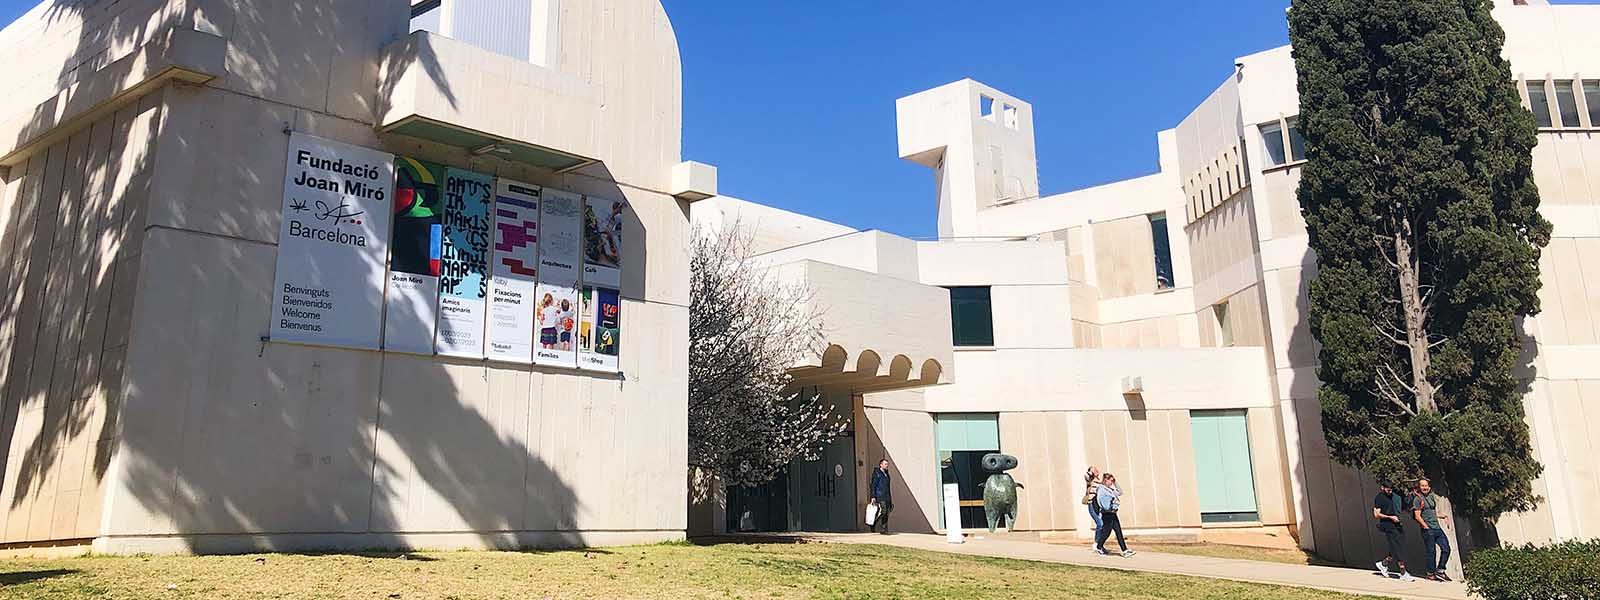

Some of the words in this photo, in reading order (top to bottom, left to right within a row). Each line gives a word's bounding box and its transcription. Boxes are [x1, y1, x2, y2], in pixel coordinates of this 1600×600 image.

[297, 150, 379, 180] Fundació
[294, 171, 339, 192] Joan
[344, 180, 385, 201] Miró
[289, 220, 366, 247] Barcelona
[392, 275, 408, 283] Joan
[408, 277, 423, 285] Miró
[283, 283, 330, 298] Benvinguts
[494, 288, 522, 299] Fixacions
[282, 295, 332, 309] Bienvenidos
[442, 298, 460, 306] Amics
[504, 297, 521, 305] minut
[281, 307, 321, 320] Welcome
[280, 319, 322, 332] Bienvenus
